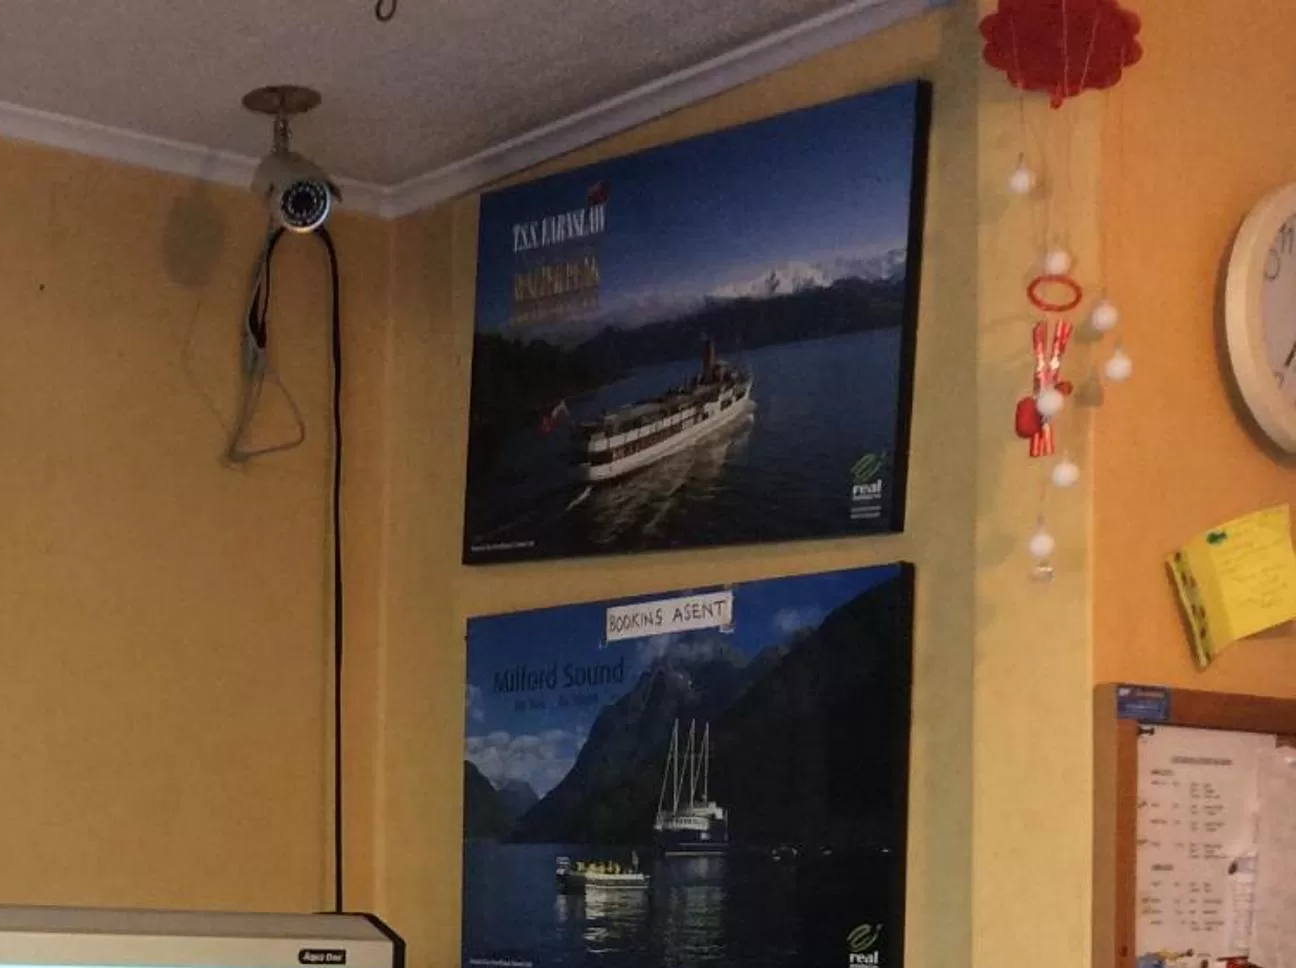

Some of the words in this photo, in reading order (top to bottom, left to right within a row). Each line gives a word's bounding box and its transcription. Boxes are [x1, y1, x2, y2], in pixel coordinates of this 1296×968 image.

[494, 661, 557, 693] Milford
[563, 656, 625, 688] Sound
[849, 950, 879, 964] real
